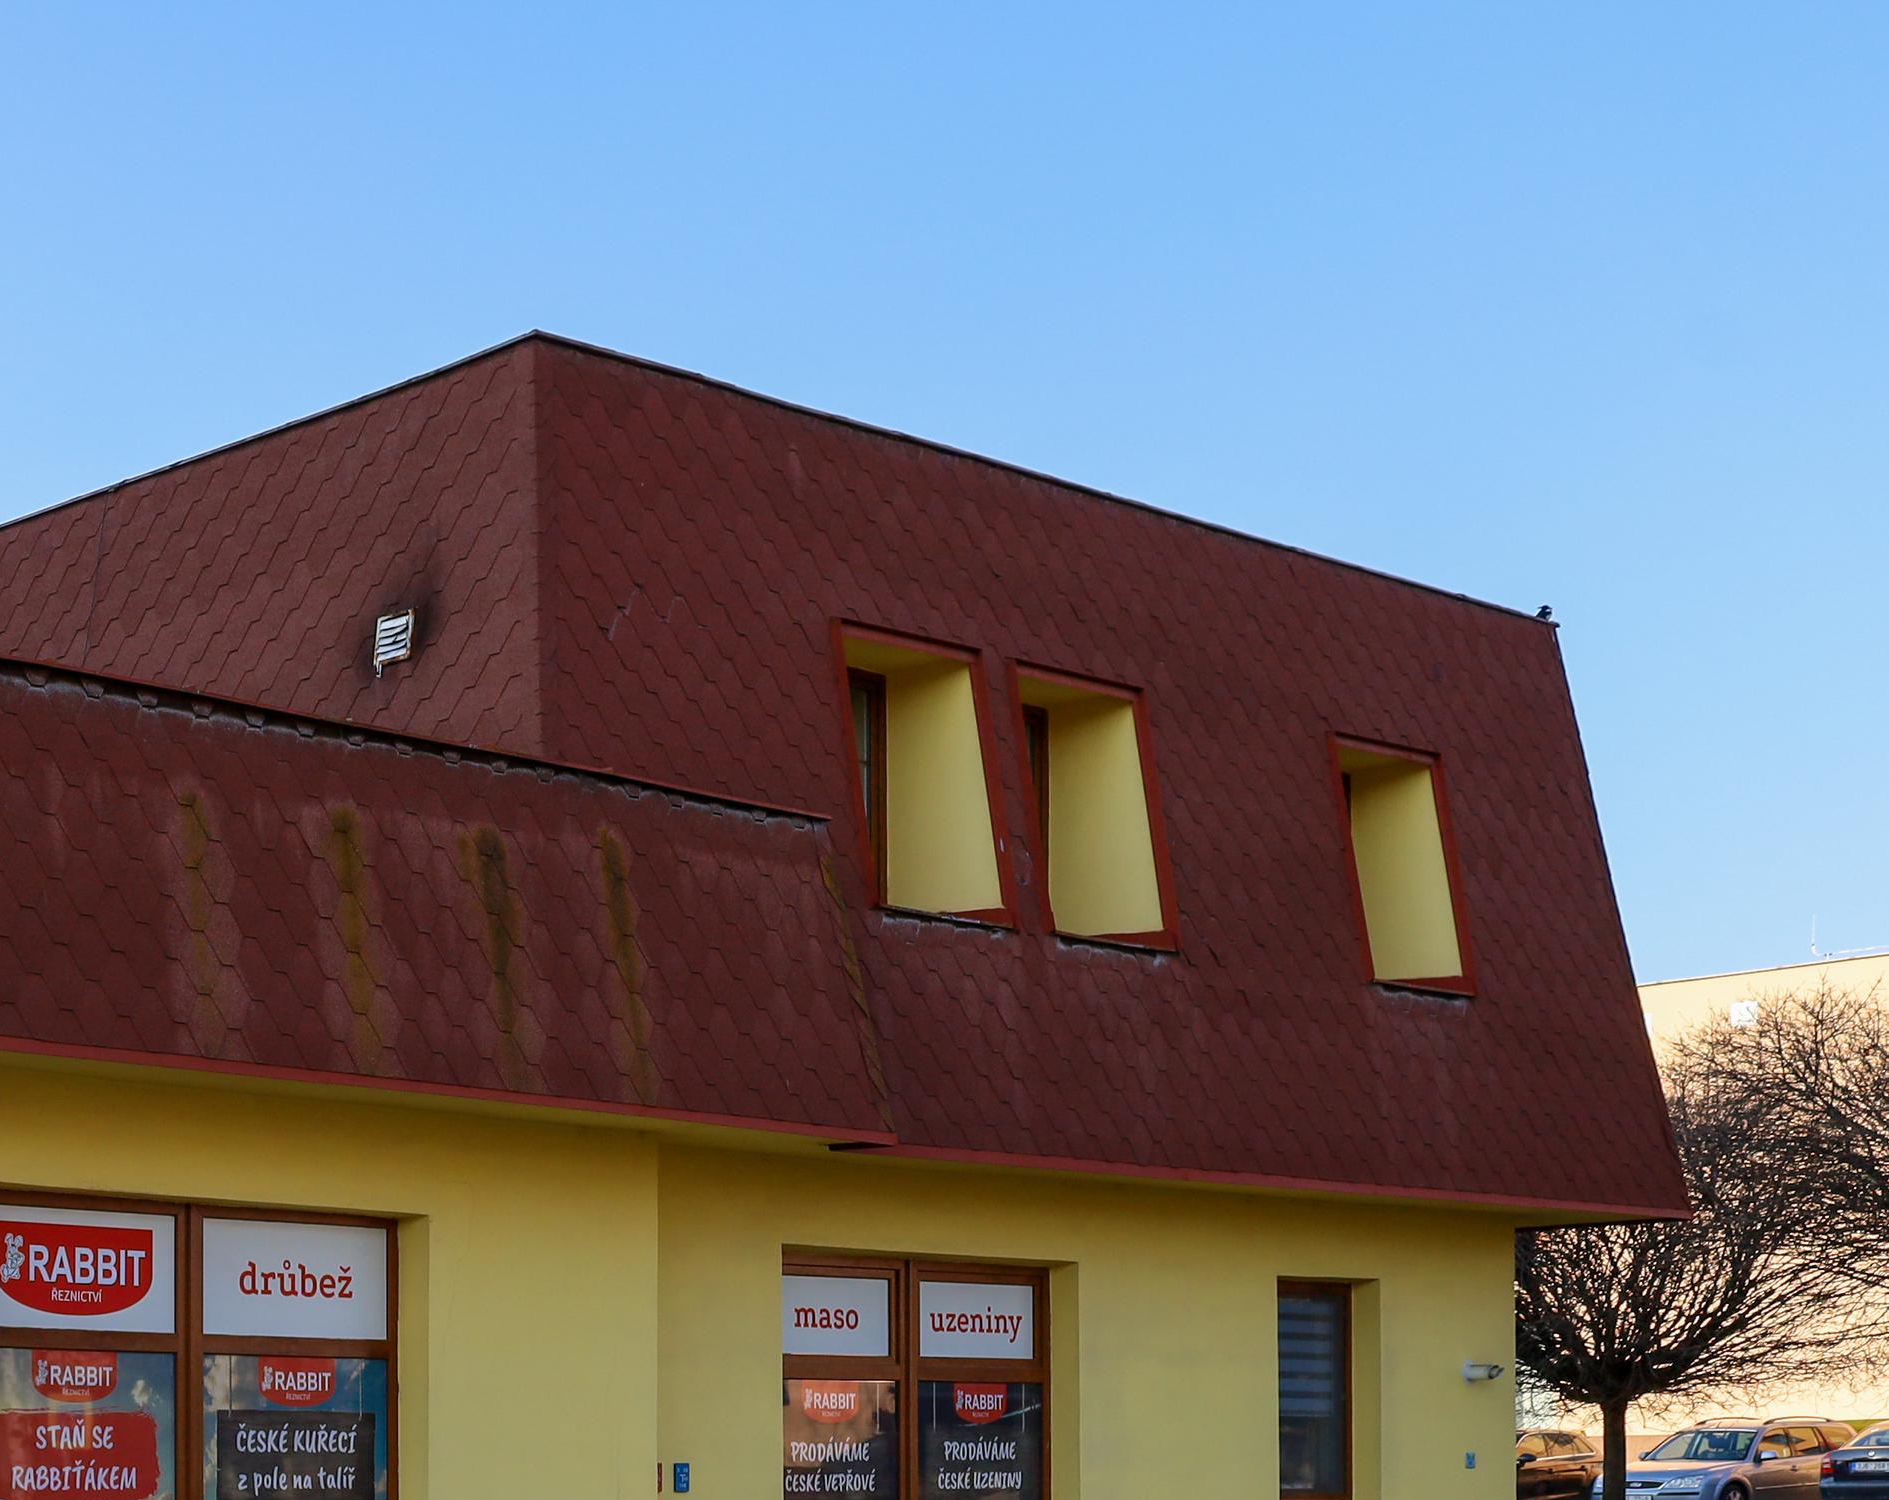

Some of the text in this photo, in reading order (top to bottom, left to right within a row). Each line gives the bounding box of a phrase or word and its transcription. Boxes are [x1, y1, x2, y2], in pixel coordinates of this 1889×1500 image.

[29, 1244, 146, 1287] RABBIT
[239, 1260, 353, 1298] drůbež
[51, 1287, 103, 1302] ŘEZNICTVÍ
[794, 1307, 859, 1330] maso
[930, 1306, 1022, 1343] uzeniny
[50, 1365, 113, 1387] RABBIT
[275, 1371, 331, 1391] RABBIT
[813, 1392, 856, 1410] RABBIT
[964, 1394, 1004, 1410] RABBIT
[36, 1418, 114, 1450] STAŇ SE
[236, 1422, 358, 1454] ČESKÉ KUŘECÍ
[791, 1436, 871, 1463] PRODÁVÁME
[943, 1435, 1017, 1461] PRODÁVÁME
[11, 1459, 137, 1492] RABBIŤÁKEM
[238, 1465, 356, 1497] z pole na talíř
[785, 1468, 876, 1493] ČESKÉ VEPŘOVÉ
[938, 1466, 1022, 1490] ČESKÉ UZENINY
